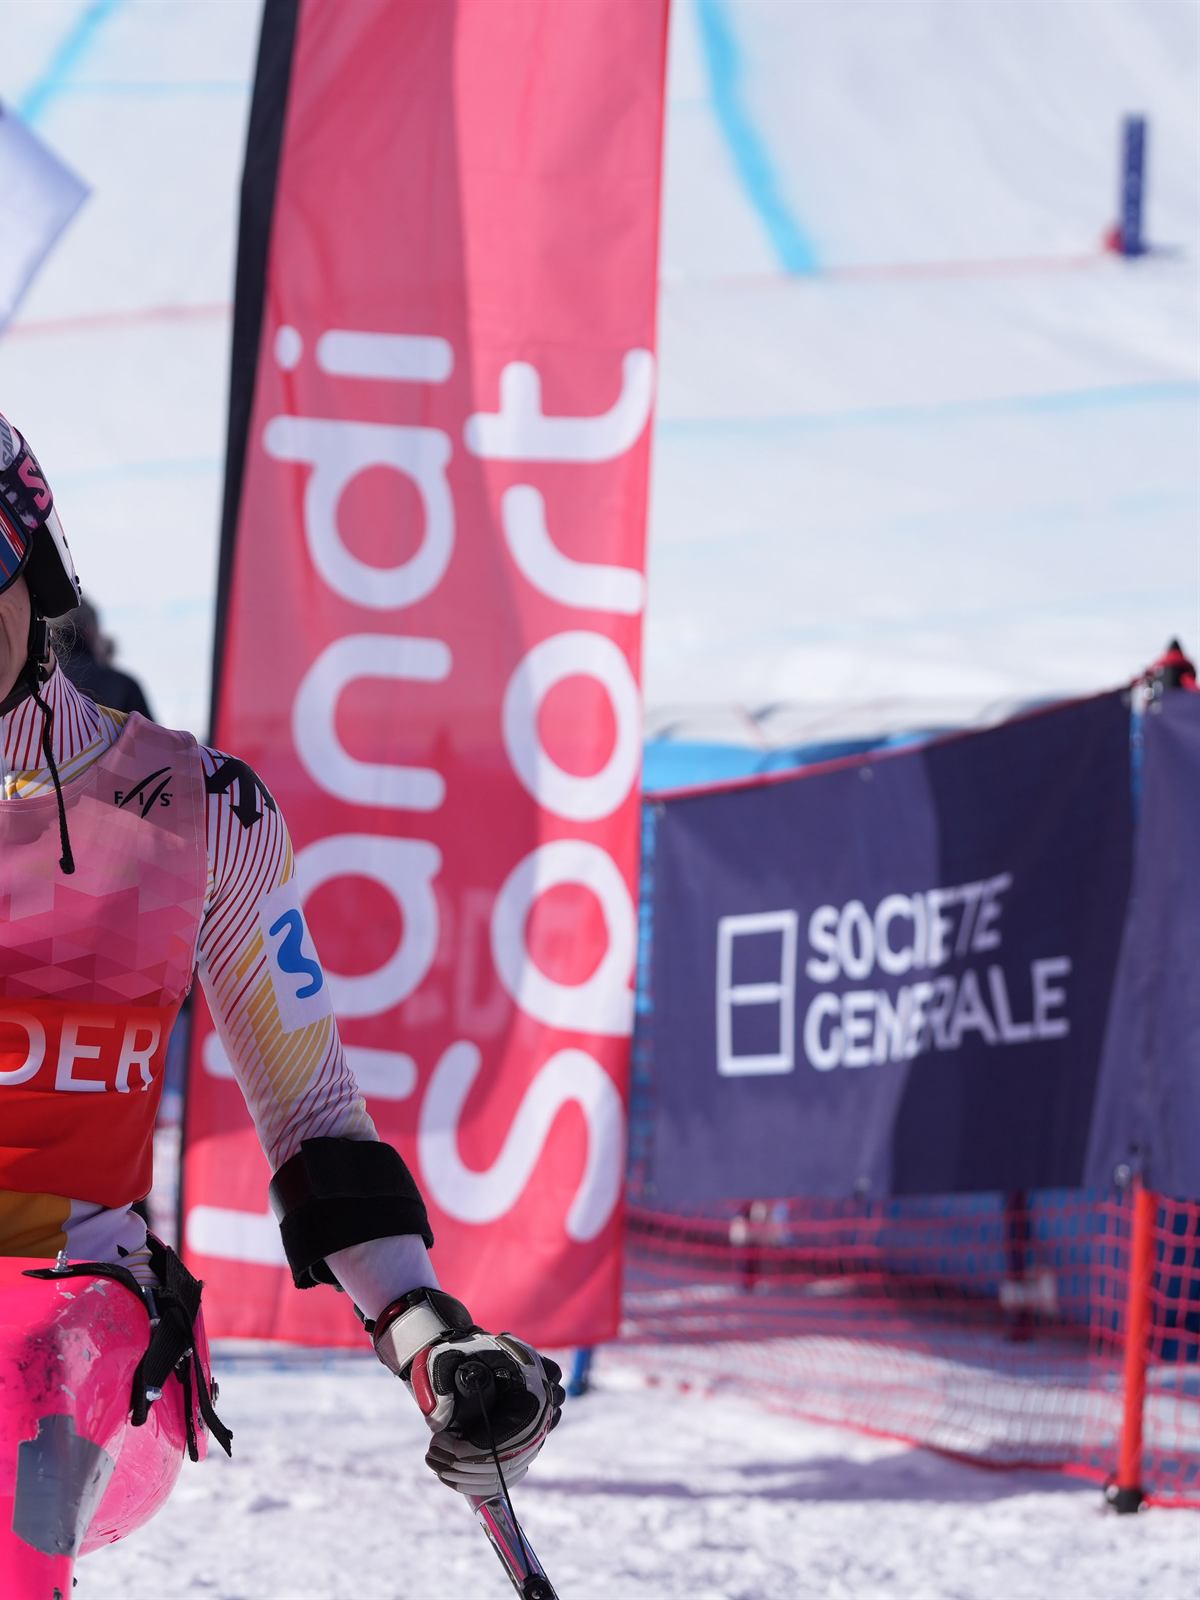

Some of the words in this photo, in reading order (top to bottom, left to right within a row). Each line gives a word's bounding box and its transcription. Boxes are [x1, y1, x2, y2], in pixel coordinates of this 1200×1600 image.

[418, 347, 655, 1243] Sport
[805, 871, 1013, 984] SOCIETE
[803, 956, 1072, 1072] GENERALE
